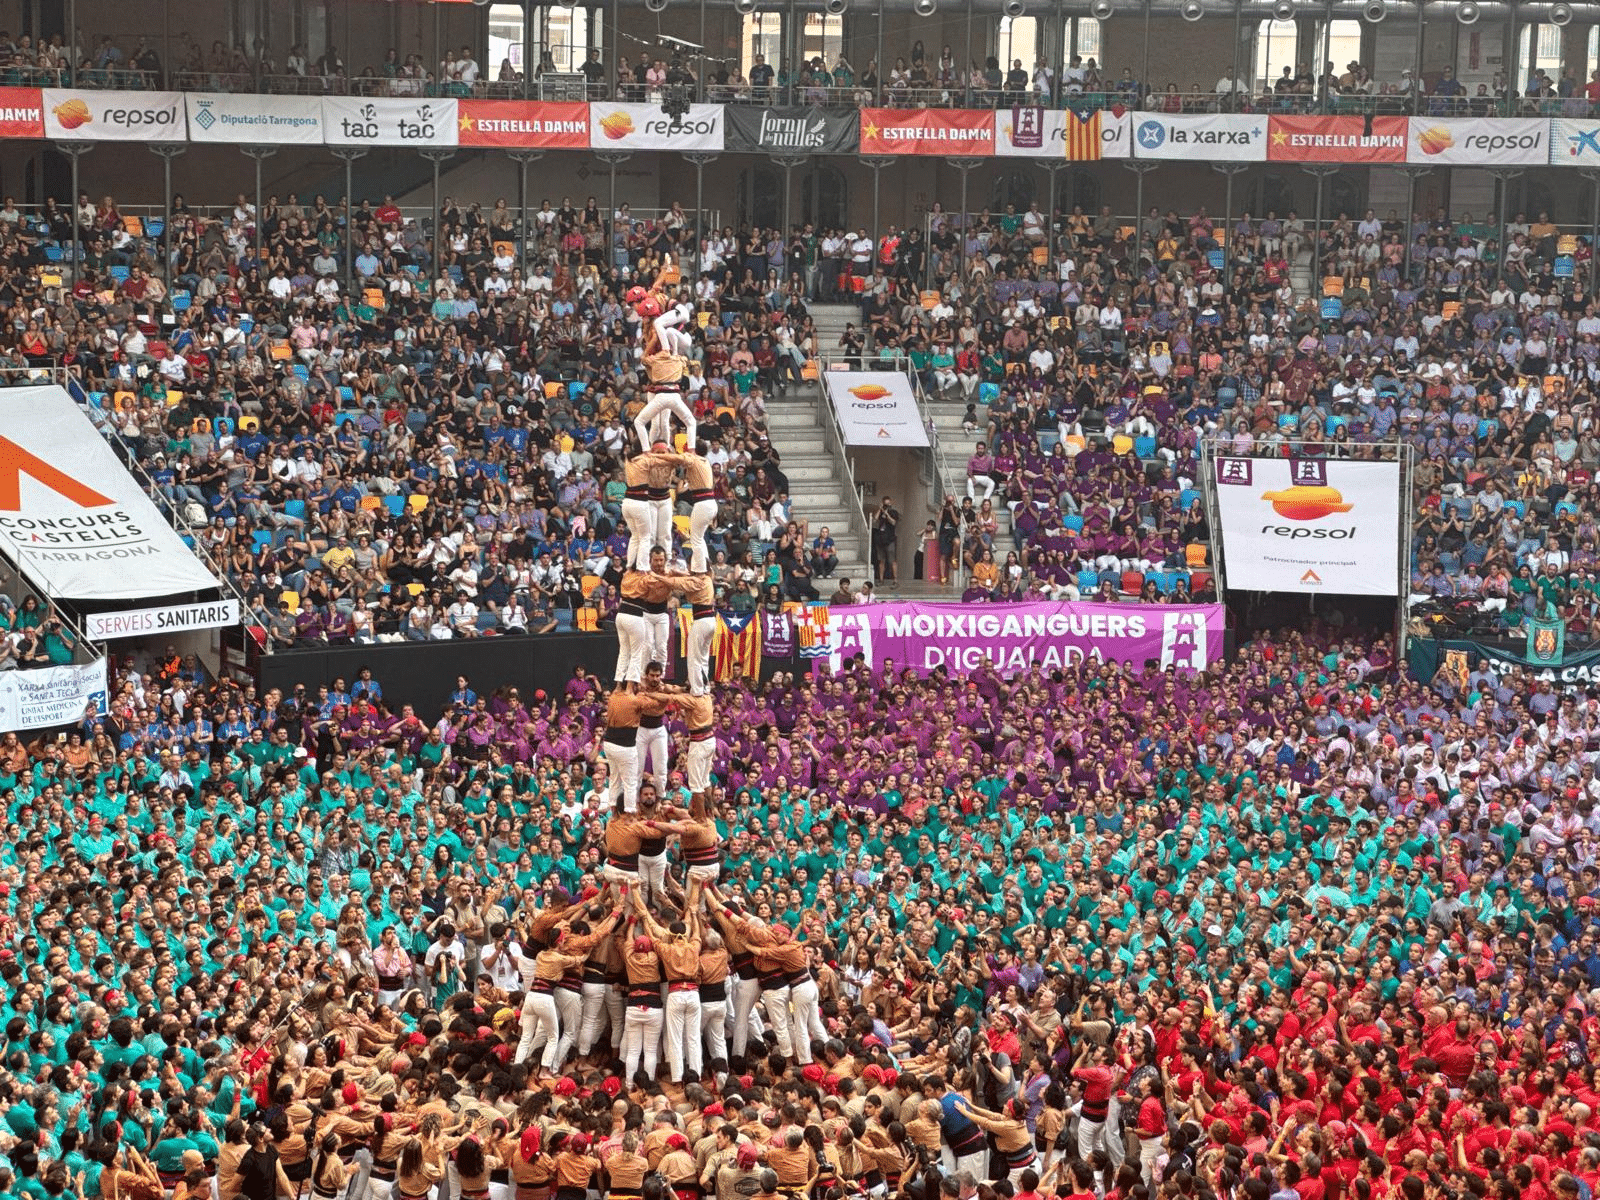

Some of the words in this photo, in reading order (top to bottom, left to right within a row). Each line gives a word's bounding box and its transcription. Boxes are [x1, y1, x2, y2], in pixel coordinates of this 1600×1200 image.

[103, 106, 177, 128] repsol
[269, 115, 318, 128] Tarragona
[340, 117, 379, 138] tac
[397, 118, 435, 139] tac
[477, 119, 541, 133] ESTRELLA
[544, 120, 586, 134] DAMM
[883, 127, 946, 140] ESTRELLA
[949, 127, 991, 140] DAMM
[1051, 125, 1123, 142] reol
[1169, 127, 1188, 142] la
[1290, 133, 1357, 147] ESTRELLA
[1359, 135, 1404, 148] DAMM
[1464, 131, 1541, 153] repsol
[851, 401, 897, 410] repsol
[0, 511, 130, 529] CONCURS
[9, 525, 143, 543] CASTELLS
[1261, 525, 1357, 540] repsol
[26, 545, 161, 562] TARRAGONA
[97, 613, 152, 635] SERVEIS
[157, 605, 230, 628] SANITARIS
[885, 614, 1146, 638] MOIXIGANGUERS
